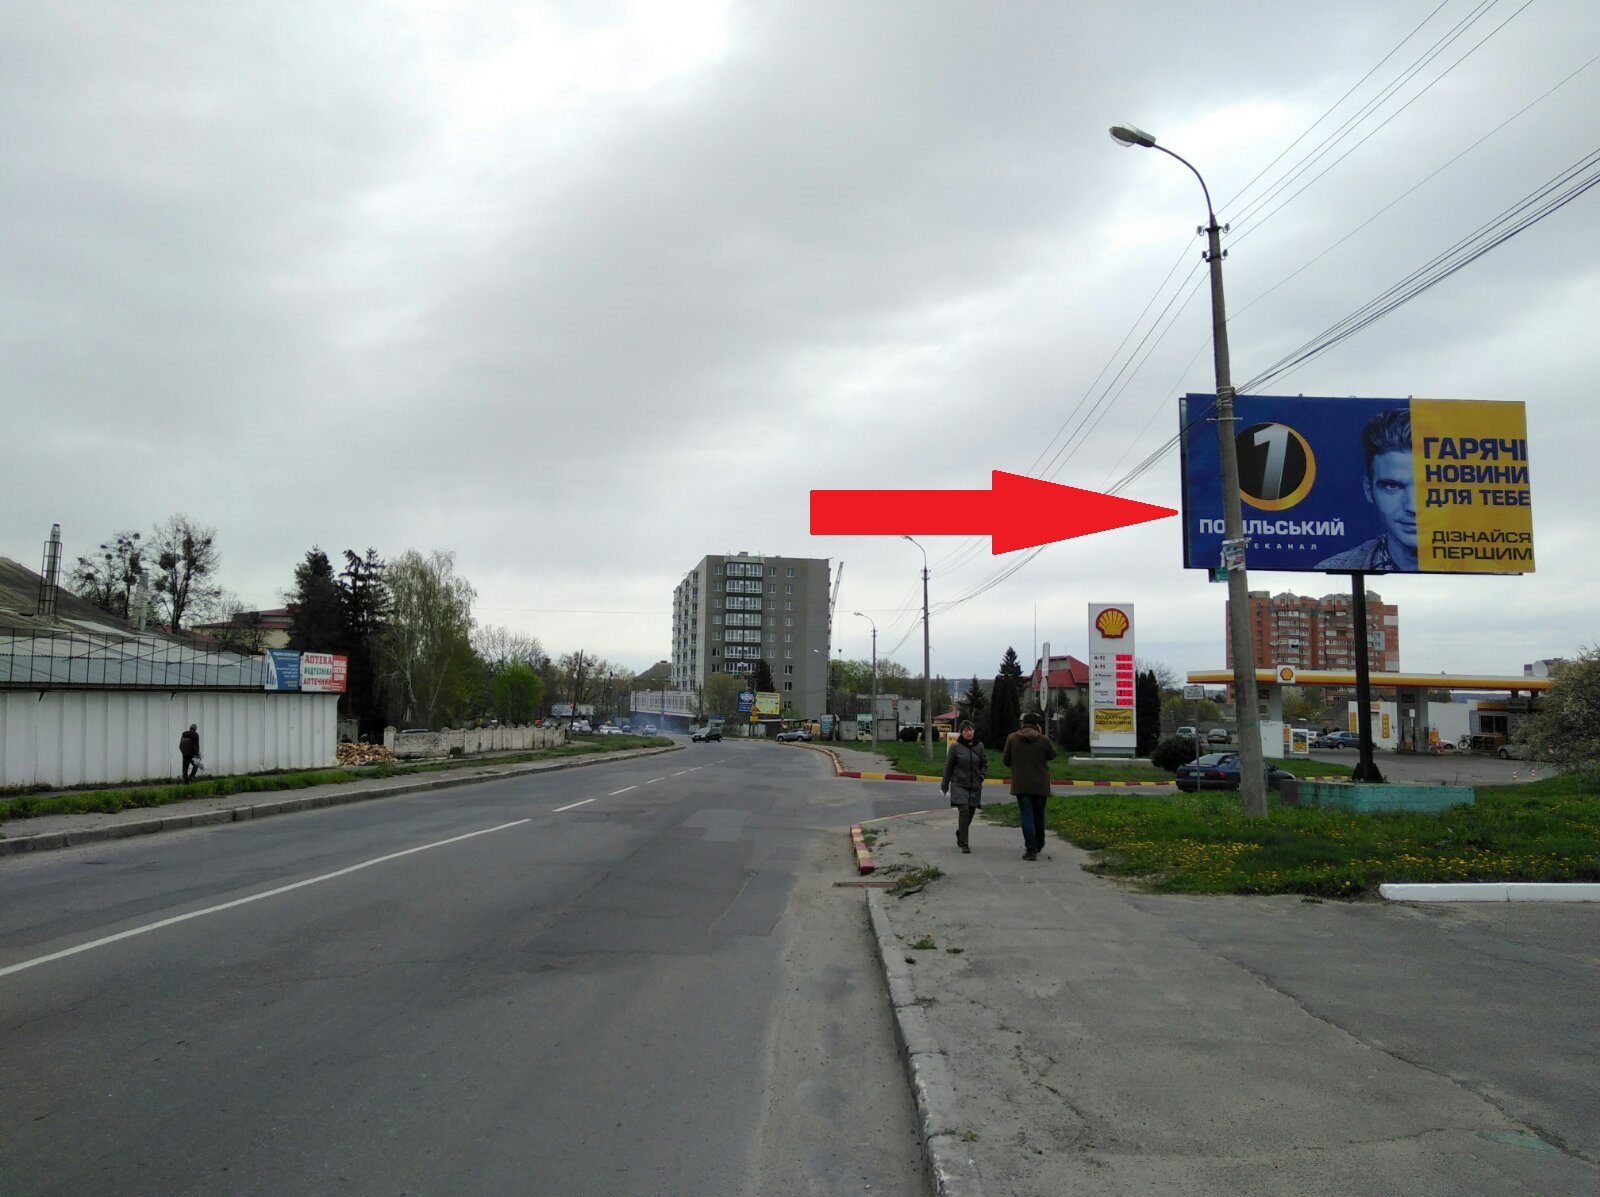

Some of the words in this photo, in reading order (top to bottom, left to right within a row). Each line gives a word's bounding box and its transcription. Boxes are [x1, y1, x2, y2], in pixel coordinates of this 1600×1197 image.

[1423, 437, 1527, 461] ГАРЯЧІ
[1253, 423, 1289, 501] 1
[1425, 464, 1529, 485] НОВИНИ
[1426, 488, 1473, 508] ДЛЯ
[1479, 489, 1531, 507] ТЕБЕ
[1199, 518, 1345, 537] ПОІЛЬСЬКИЙ
[1432, 529, 1532, 545] ДІЗНАЙСЯ
[1432, 546, 1533, 561] ПЕРШИМ
